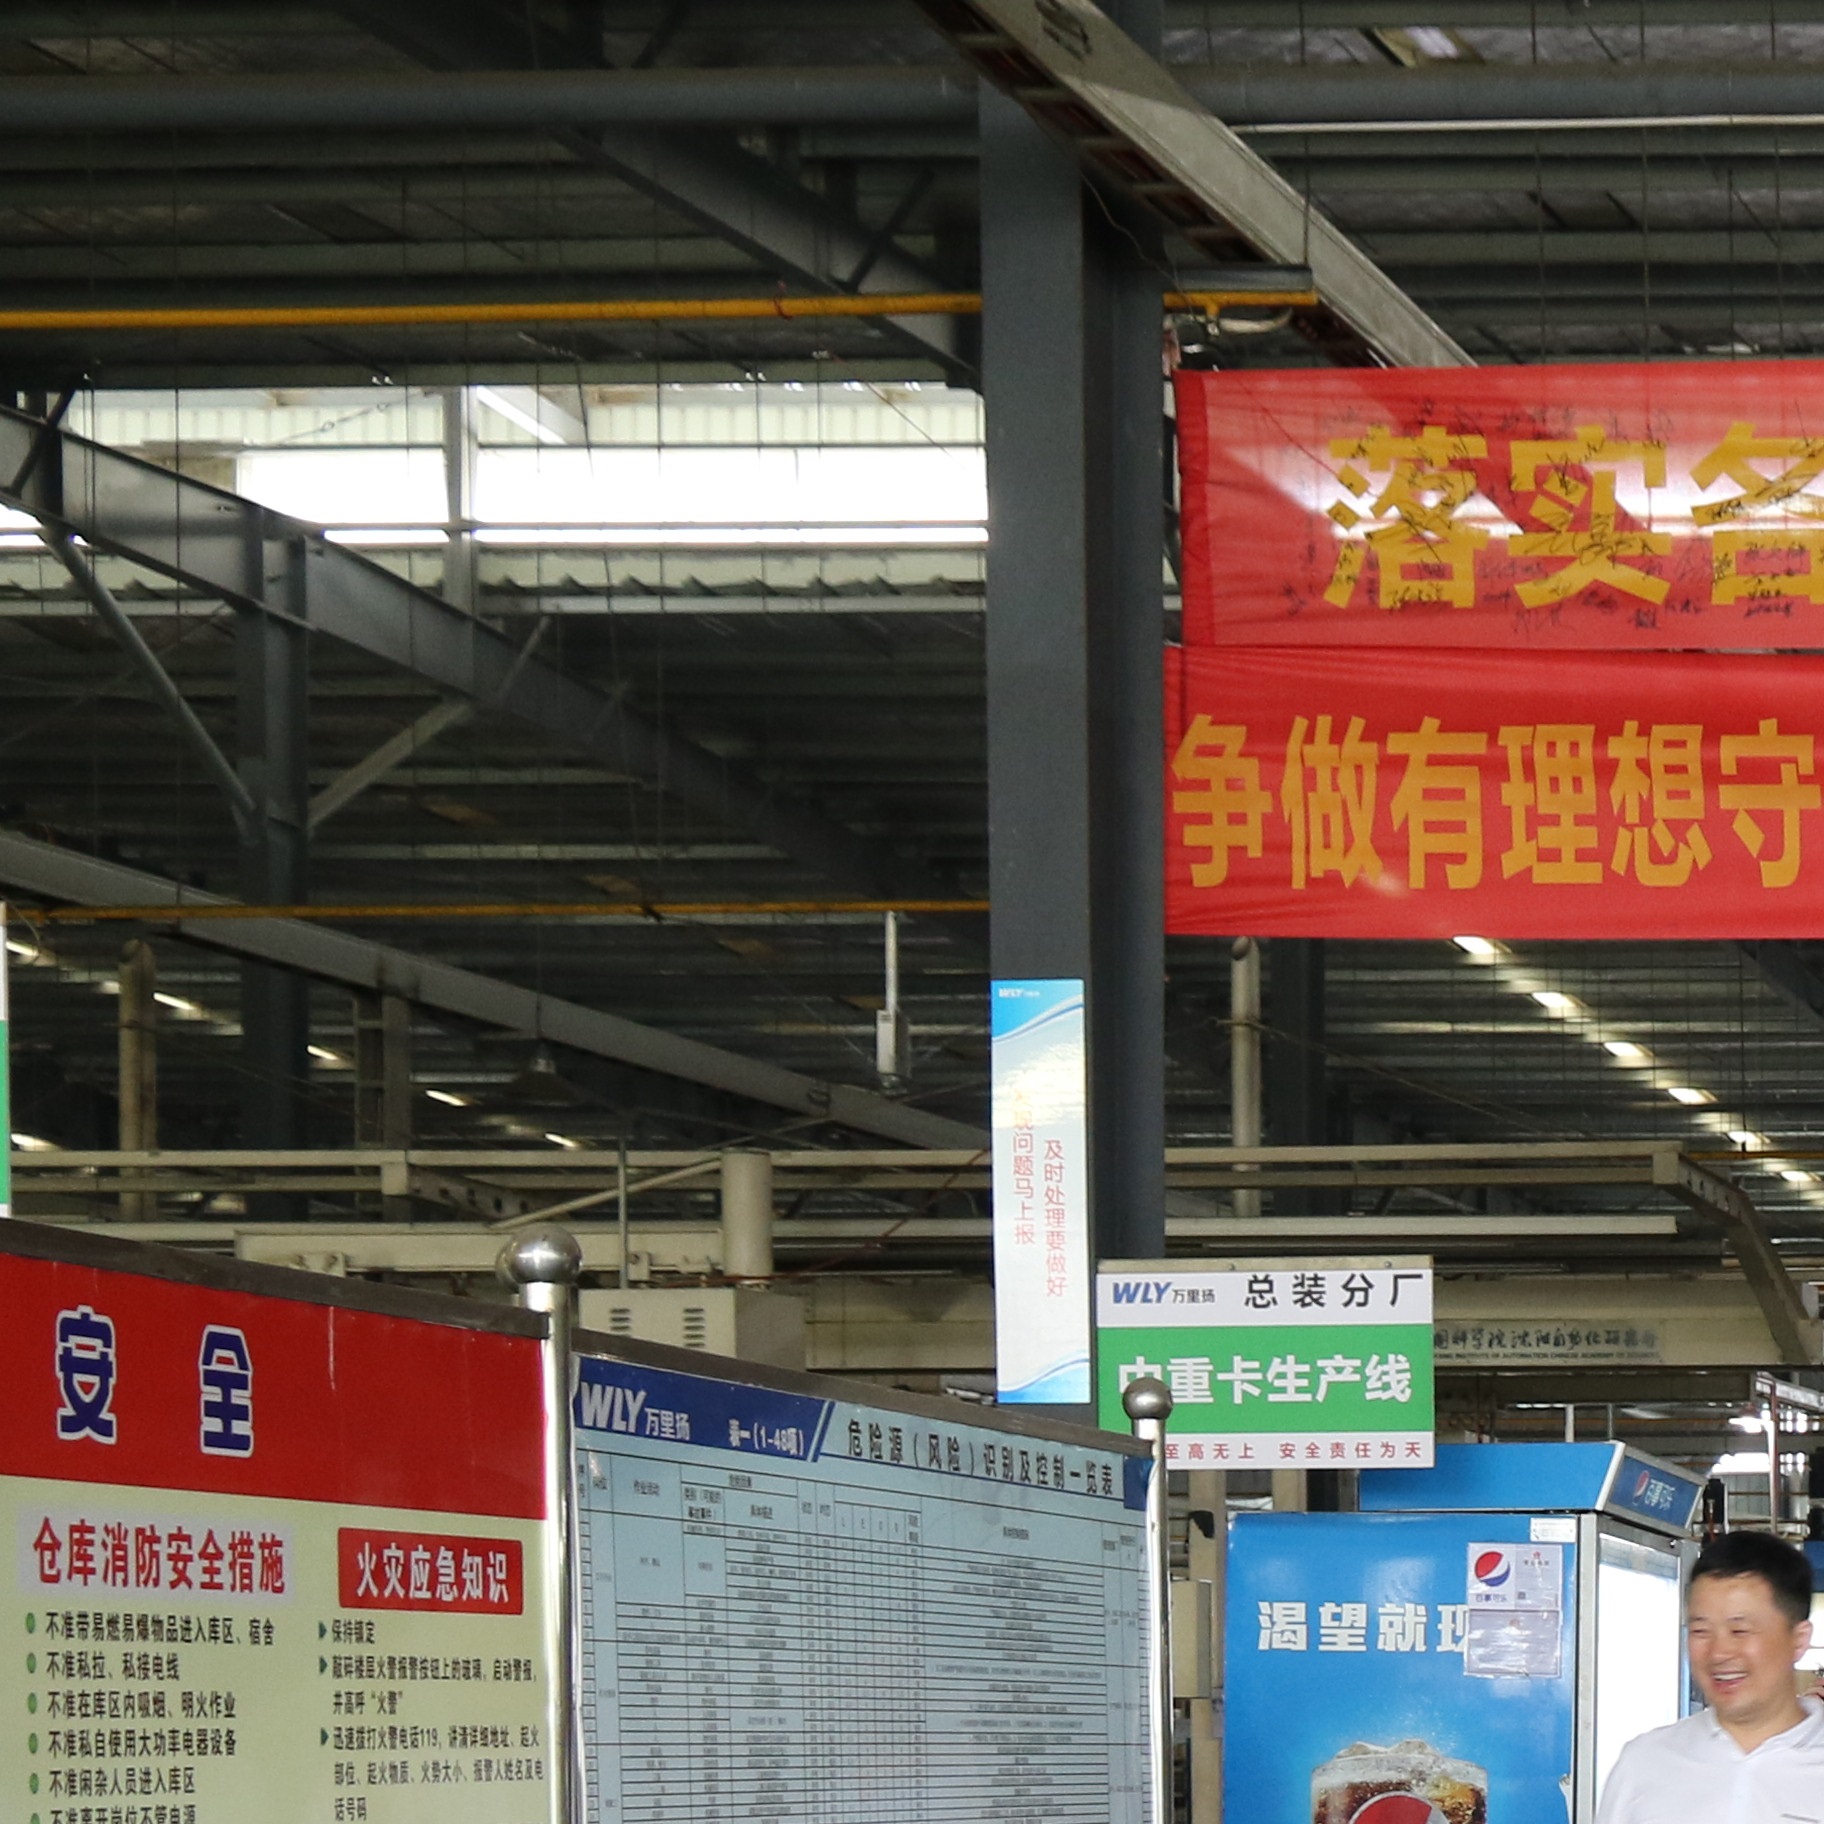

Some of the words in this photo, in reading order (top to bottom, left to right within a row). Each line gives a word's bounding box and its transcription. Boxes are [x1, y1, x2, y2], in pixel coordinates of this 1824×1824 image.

[1043, 1139, 1068, 1297] 及时处理要做好
[1113, 1282, 1172, 1304] WLY
[1172, 1287, 1216, 1305] 万里扬
[1244, 1273, 1423, 1309] 总装分厂
[56, 1305, 255, 1458] 安全
[581, 1381, 647, 1433] WLY
[644, 1406, 691, 1441] 万里扬
[1165, 1443, 1255, 1460] 至高无上
[1279, 1441, 1423, 1460] 安全责任为天
[33, 1515, 287, 1596] 仓库消防安全措施
[356, 1540, 510, 1605] 火灾应急知识
[334, 1797, 367, 1822] 话号码
